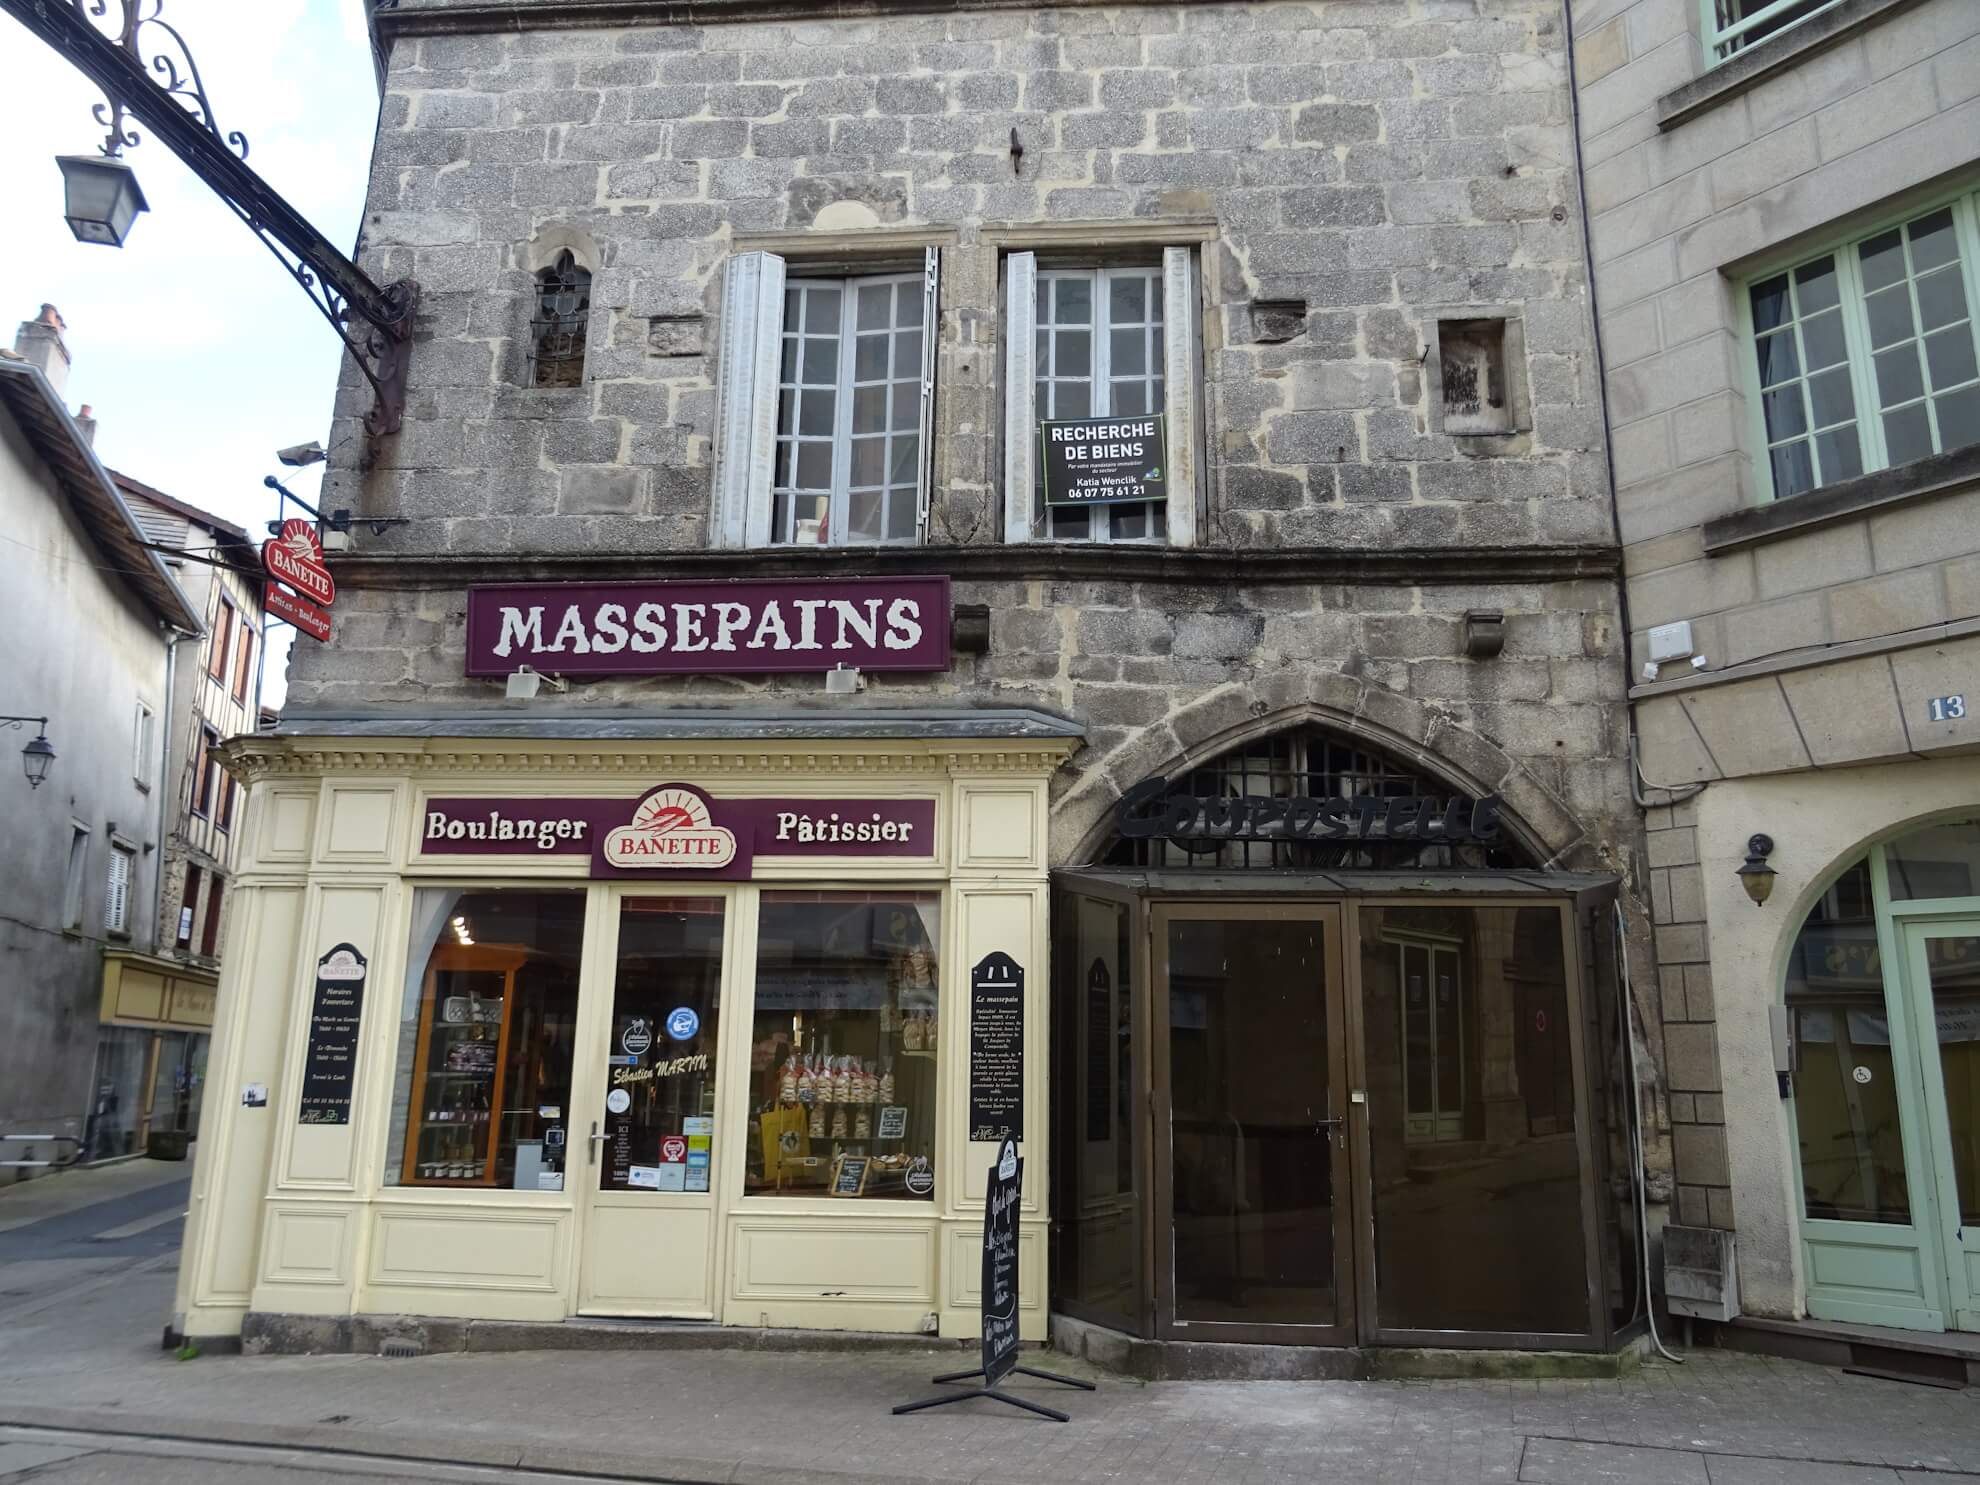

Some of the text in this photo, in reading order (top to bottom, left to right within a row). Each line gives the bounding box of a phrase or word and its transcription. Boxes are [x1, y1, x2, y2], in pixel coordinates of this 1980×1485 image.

[1052, 422, 1155, 441] RECHERCHE
[1065, 443, 1144, 460] DE BIENS
[1068, 485, 1145, 498] 06 07 75 61 21
[1077, 476, 1137, 487] Katia Wenclik
[273, 548, 329, 596] BANETTE
[298, 608, 330, 633] Boulanger
[493, 598, 923, 657] MASSEPAINS
[1931, 695, 1965, 721] 13
[426, 810, 588, 849] Boulanger
[776, 813, 913, 843] Pâtissier
[619, 837, 722, 856] BANETTE
[655, 1054, 708, 1077] MARTIN
